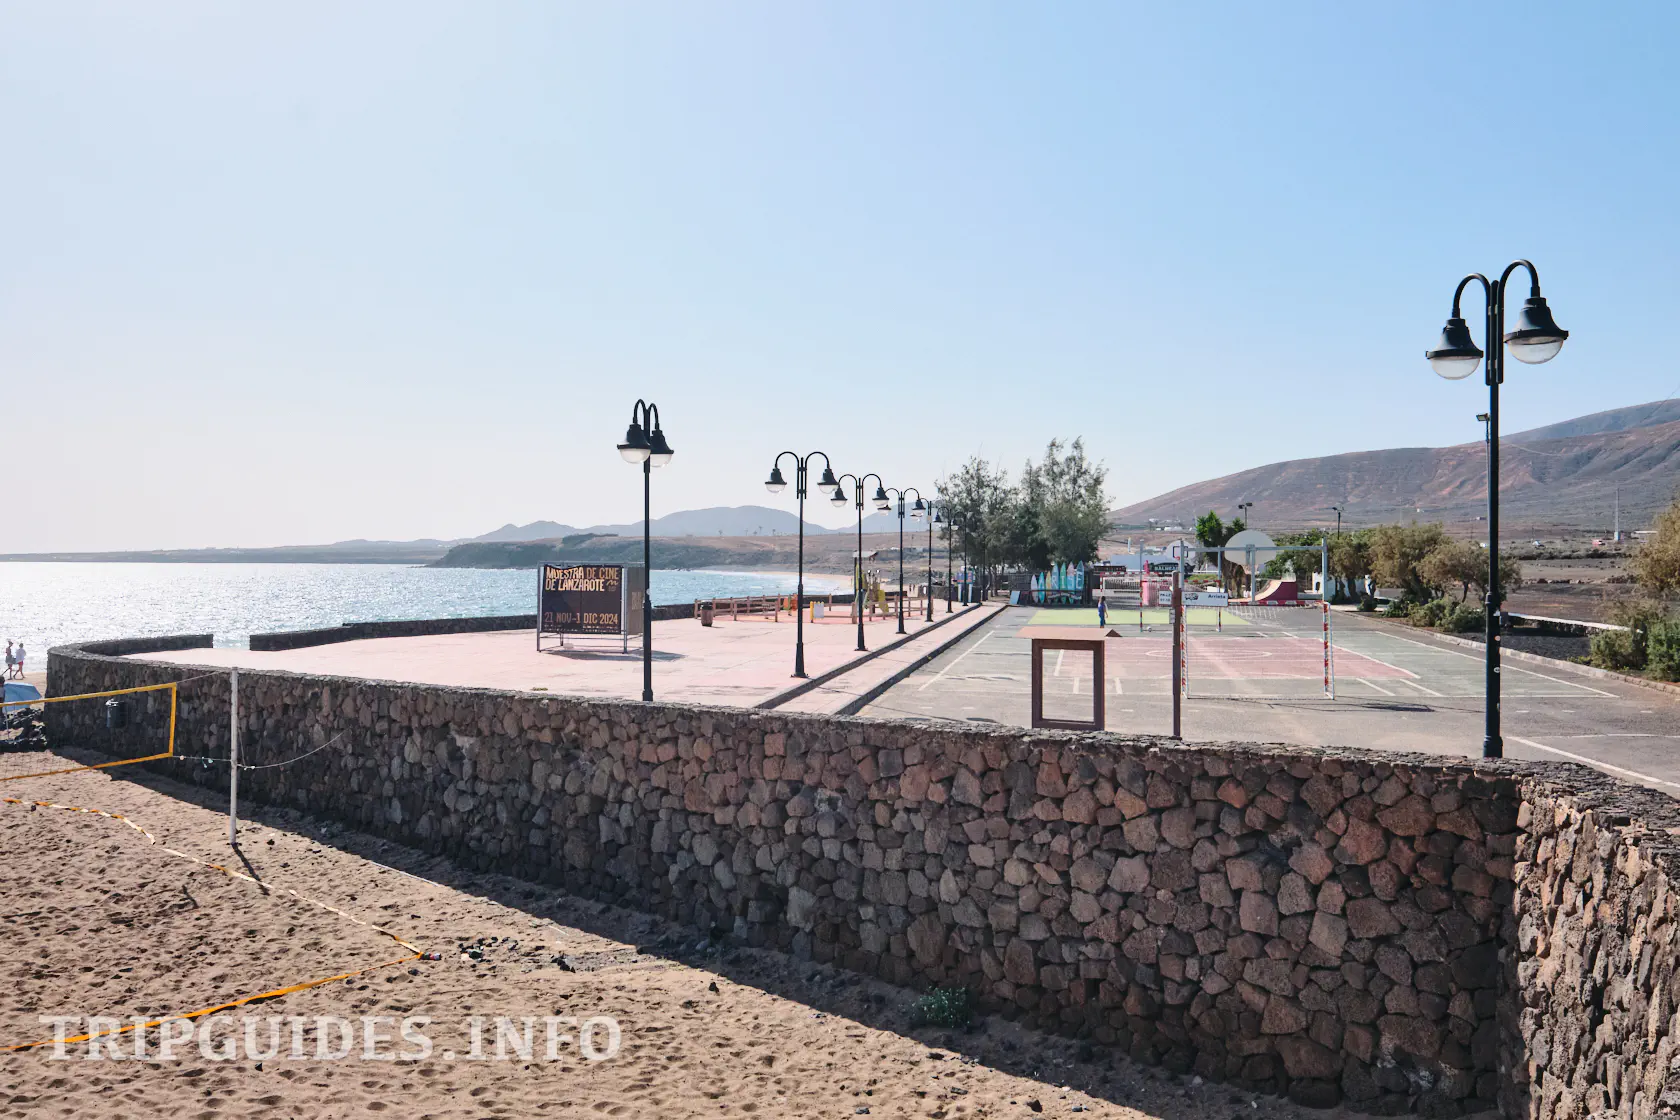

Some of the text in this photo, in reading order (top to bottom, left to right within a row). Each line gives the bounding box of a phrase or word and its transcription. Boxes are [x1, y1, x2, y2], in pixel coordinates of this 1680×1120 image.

[546, 566, 619, 580] MUESTRA DE CINE
[545, 579, 556, 591] DE
[558, 579, 605, 592] LANZAROTE
[583, 613, 598, 624] DIC
[599, 613, 619, 625] 2024
